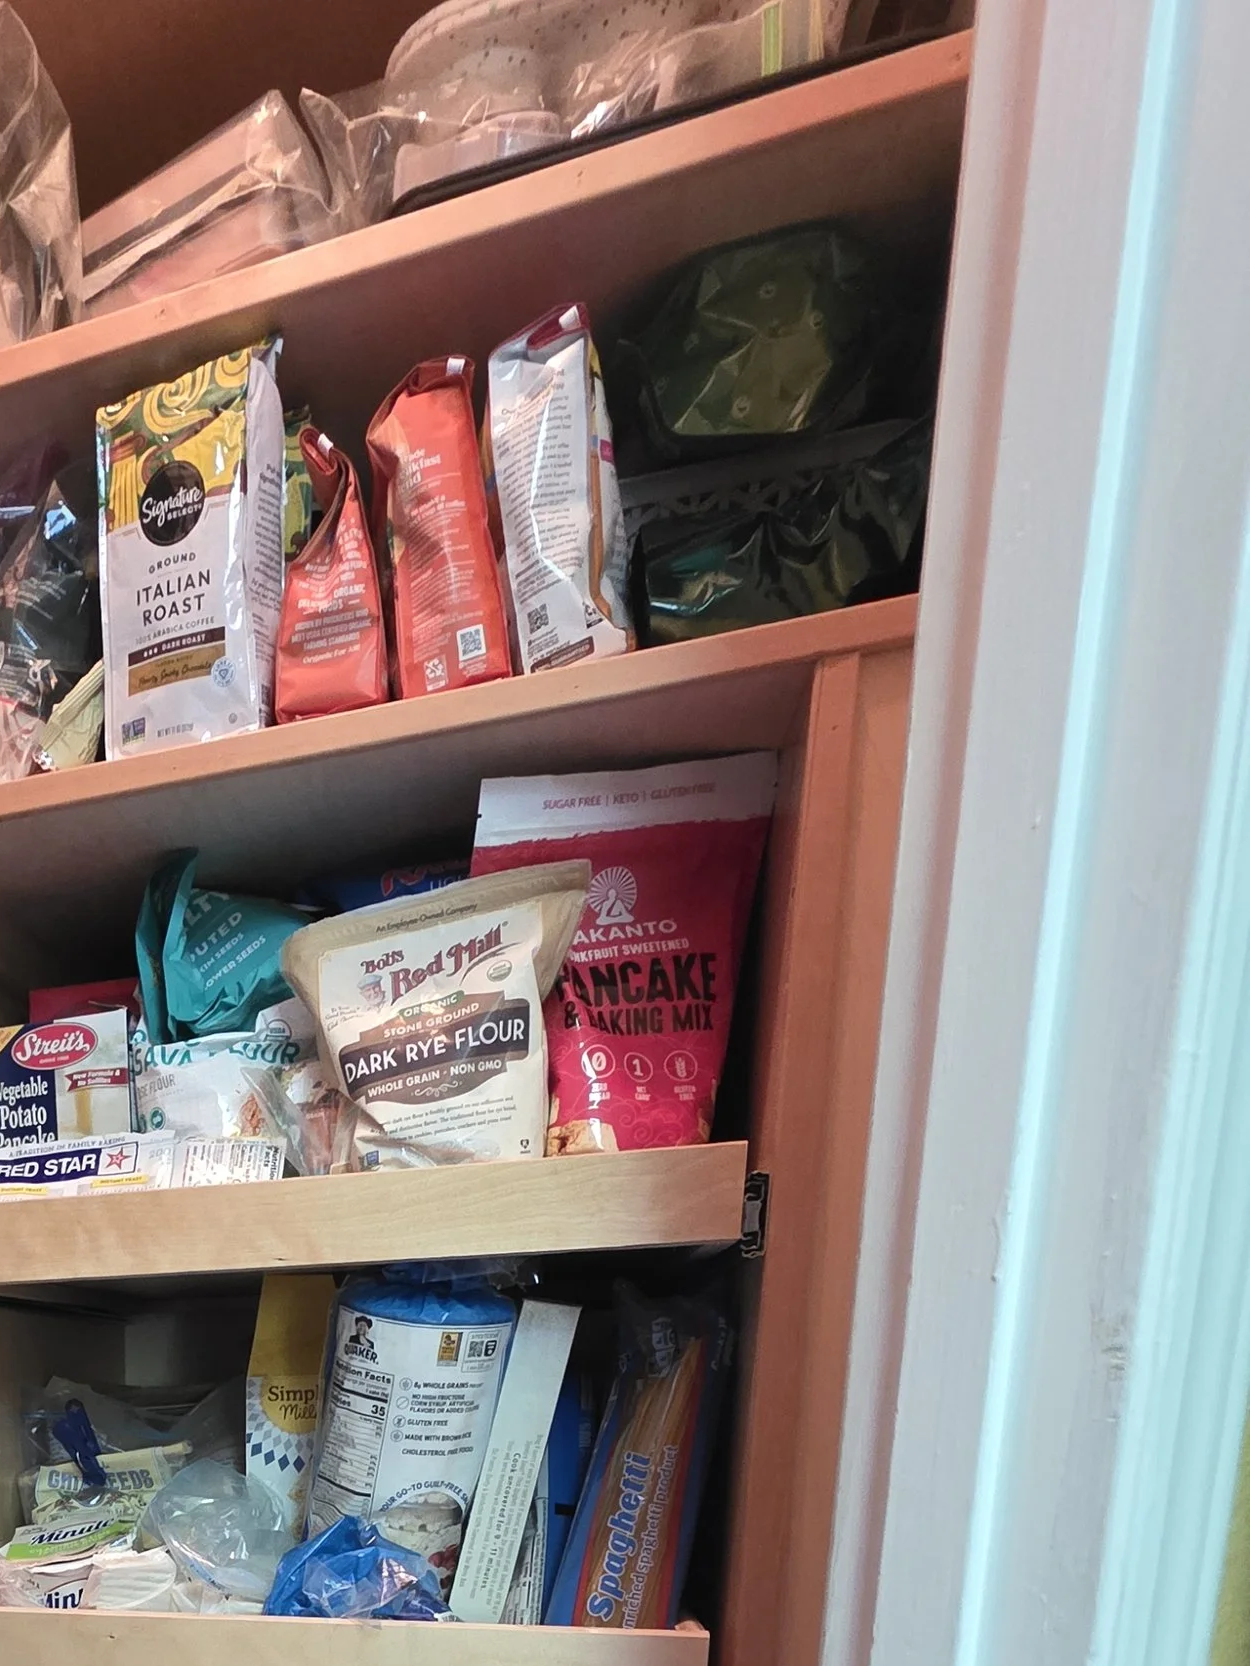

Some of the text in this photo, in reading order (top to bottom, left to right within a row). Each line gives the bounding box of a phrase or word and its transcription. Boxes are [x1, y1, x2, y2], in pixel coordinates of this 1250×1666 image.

[142, 486, 203, 527] Signature
[149, 552, 197, 574] GROUND
[136, 568, 211, 607] ITALIAN
[142, 593, 205, 627] ROAST
[153, 616, 215, 640] ARABICA COFFEE
[543, 791, 639, 810] SUGAR FREE KETO
[446, 904, 478, 917] Company
[572, 919, 678, 947] AKANTO
[215, 932, 245, 960] SEEDS
[236, 935, 268, 964] SEEDS
[622, 937, 690, 956] SWEETENED
[360, 921, 503, 1006] Bob's Red Mill
[403, 995, 458, 1018] ORGANIC
[672, 1003, 714, 1032] MIX
[384, 1002, 480, 1038] STONE GROUND
[16, 1030, 90, 1062] Streit's
[344, 1018, 525, 1084] DARK RYE FLOUR
[367, 1059, 502, 1098] WHOLE GRAIN NON GMO
[632, 1058, 644, 1076] 1
[150, 1074, 176, 1094] FLOUR
[0, 1103, 48, 1130] Potato
[68, 1140, 96, 1150] FAMILY
[43, 1153, 97, 1177] STAR
[365, 1370, 391, 1385] Facts
[422, 1381, 469, 1389] WHOLE GRAINS
[371, 1404, 386, 1417] 35
[407, 1419, 432, 1427] GLUTEN
[402, 1448, 447, 1456] CHOLESTEROL
[510, 1451, 522, 1473] Cook
[396, 1482, 423, 1499] GO-TO
[498, 1475, 514, 1518] uncovered
[639, 1444, 679, 1576] spaghetti product
[587, 1452, 651, 1622] Spaghetti
